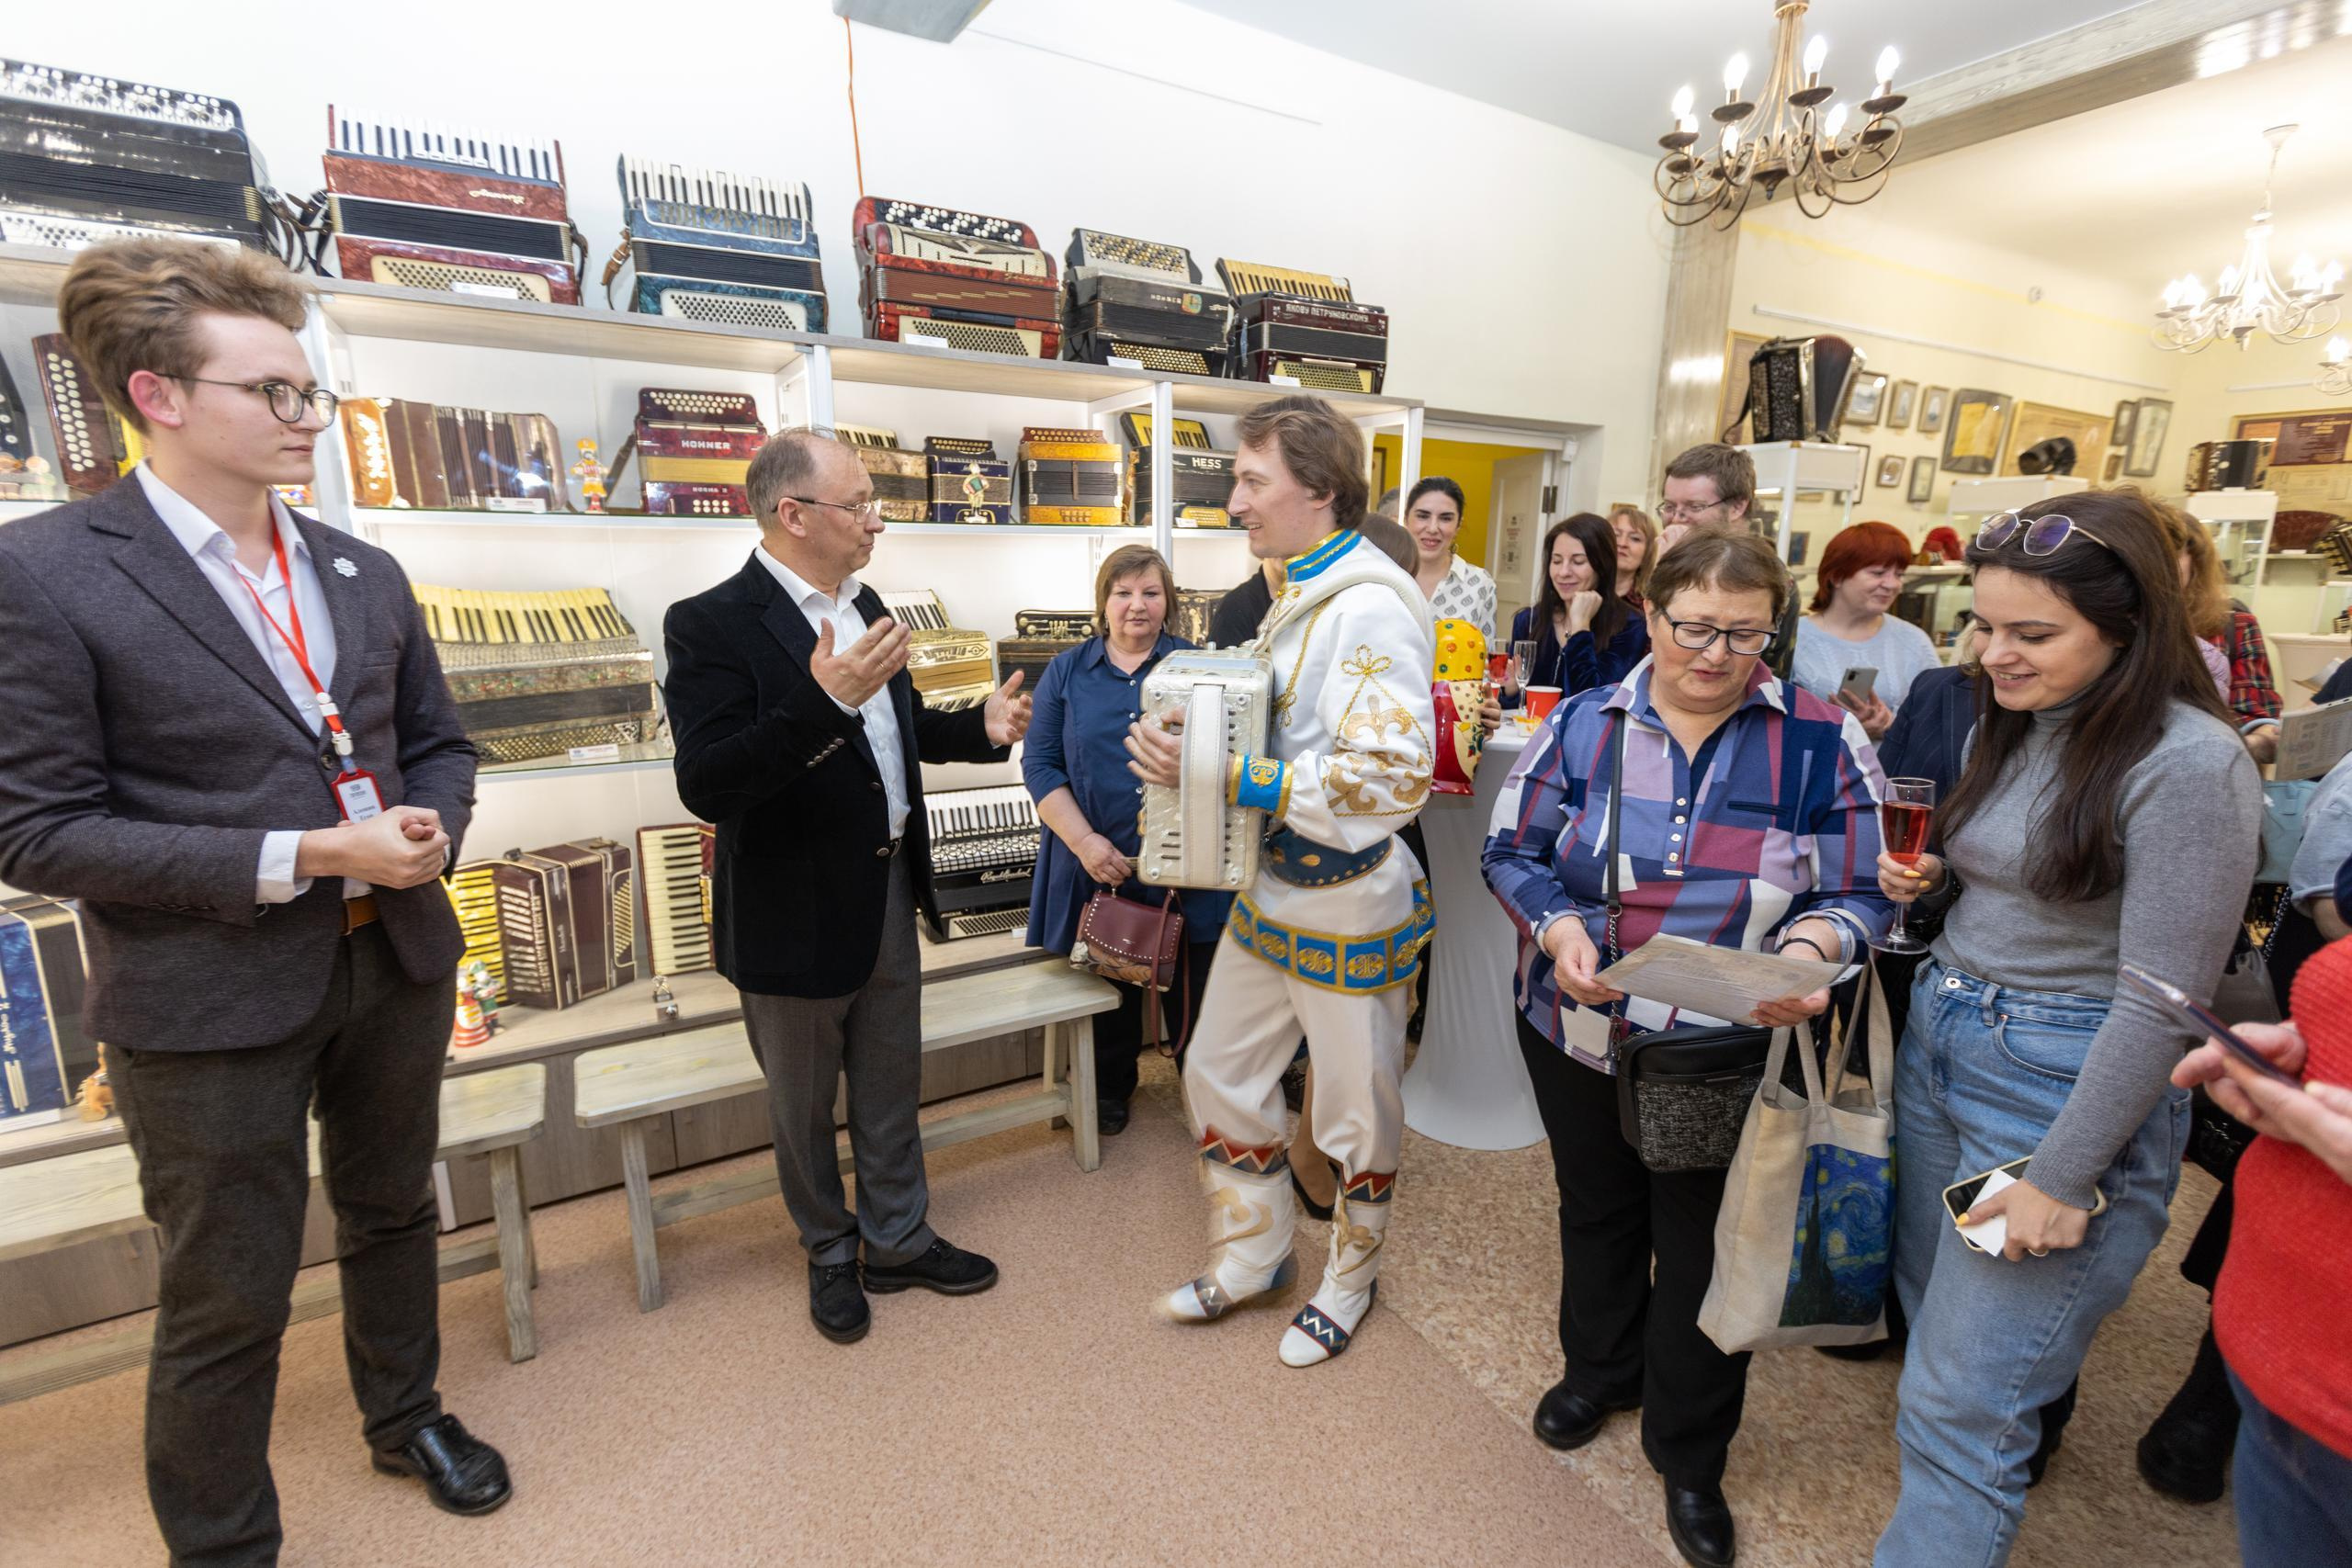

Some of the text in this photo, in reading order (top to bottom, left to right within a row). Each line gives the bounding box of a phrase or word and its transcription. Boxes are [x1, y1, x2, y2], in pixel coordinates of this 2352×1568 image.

[1150, 294, 1182, 304] HOHNER
[1285, 303, 1310, 314] ЯКОВУ
[681, 440, 731, 449] HOHNER
[1192, 457, 1222, 468] HESS
